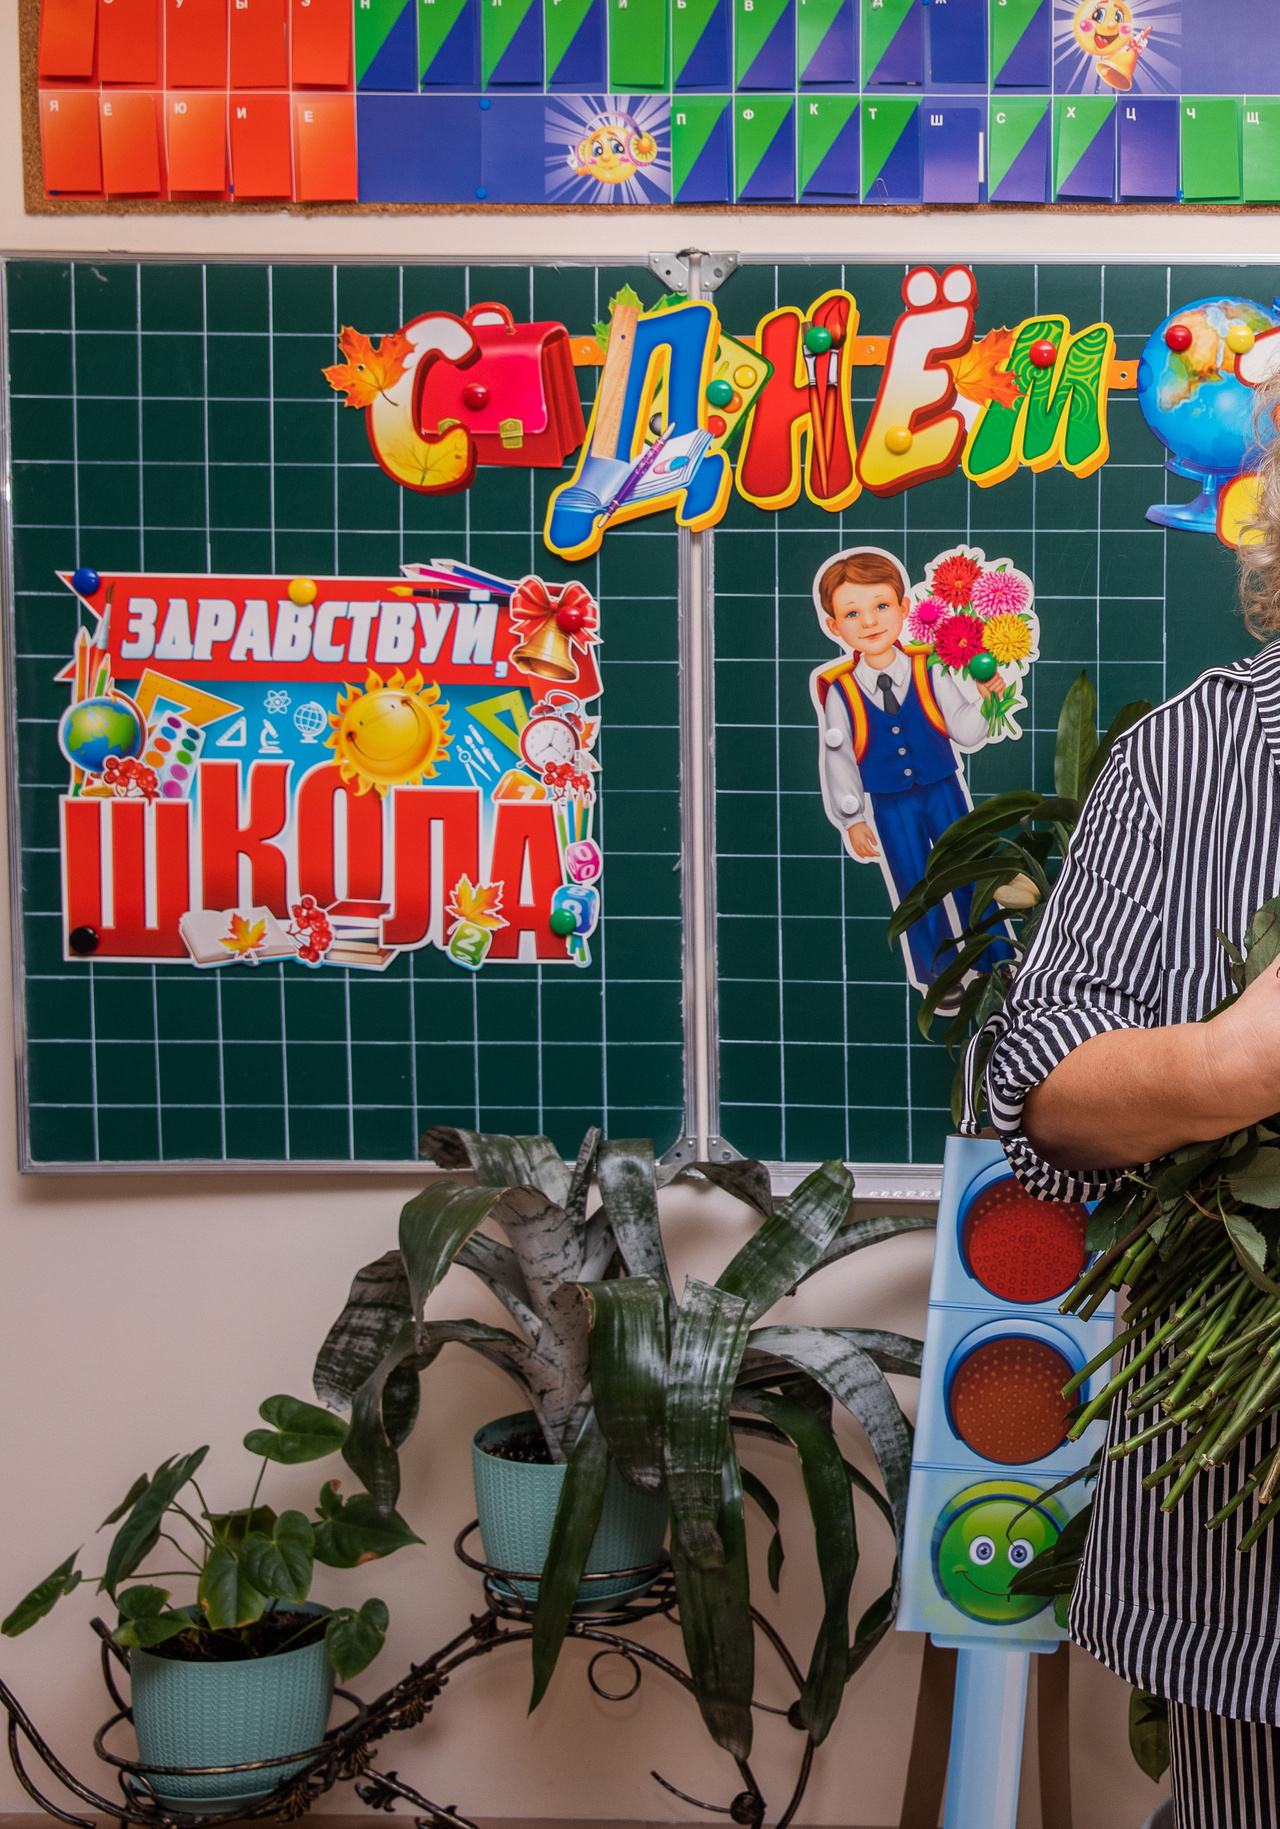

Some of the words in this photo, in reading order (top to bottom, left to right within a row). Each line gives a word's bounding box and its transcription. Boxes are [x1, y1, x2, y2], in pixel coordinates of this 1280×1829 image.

[235, 0, 248, 9] Ы
[360, 0, 371, 9] Н
[744, 0, 754, 11] В
[49, 100, 59, 112] Я
[103, 102, 113, 117] Ё
[174, 102, 187, 114] Ю
[236, 107, 247, 119] И
[304, 110, 314, 123] Е
[676, 113, 687, 125] П
[742, 109, 754, 121] Ф
[809, 103, 819, 116] К
[868, 107, 878, 120] Т
[930, 114, 943, 126] Ш
[996, 112, 1006, 124] С
[1066, 106, 1076, 118] Х
[1126, 107, 1137, 121] Ц
[1186, 107, 1196, 119] Ч
[1246, 111, 1259, 124] Щ
[366, 310, 483, 497] С
[544, 264, 1118, 562] ДНЁМ
[121, 590, 510, 679] ЗДРАВСТВУЙ,
[62, 760, 575, 962] ШКОЛА
[456, 928, 482, 952] 2
